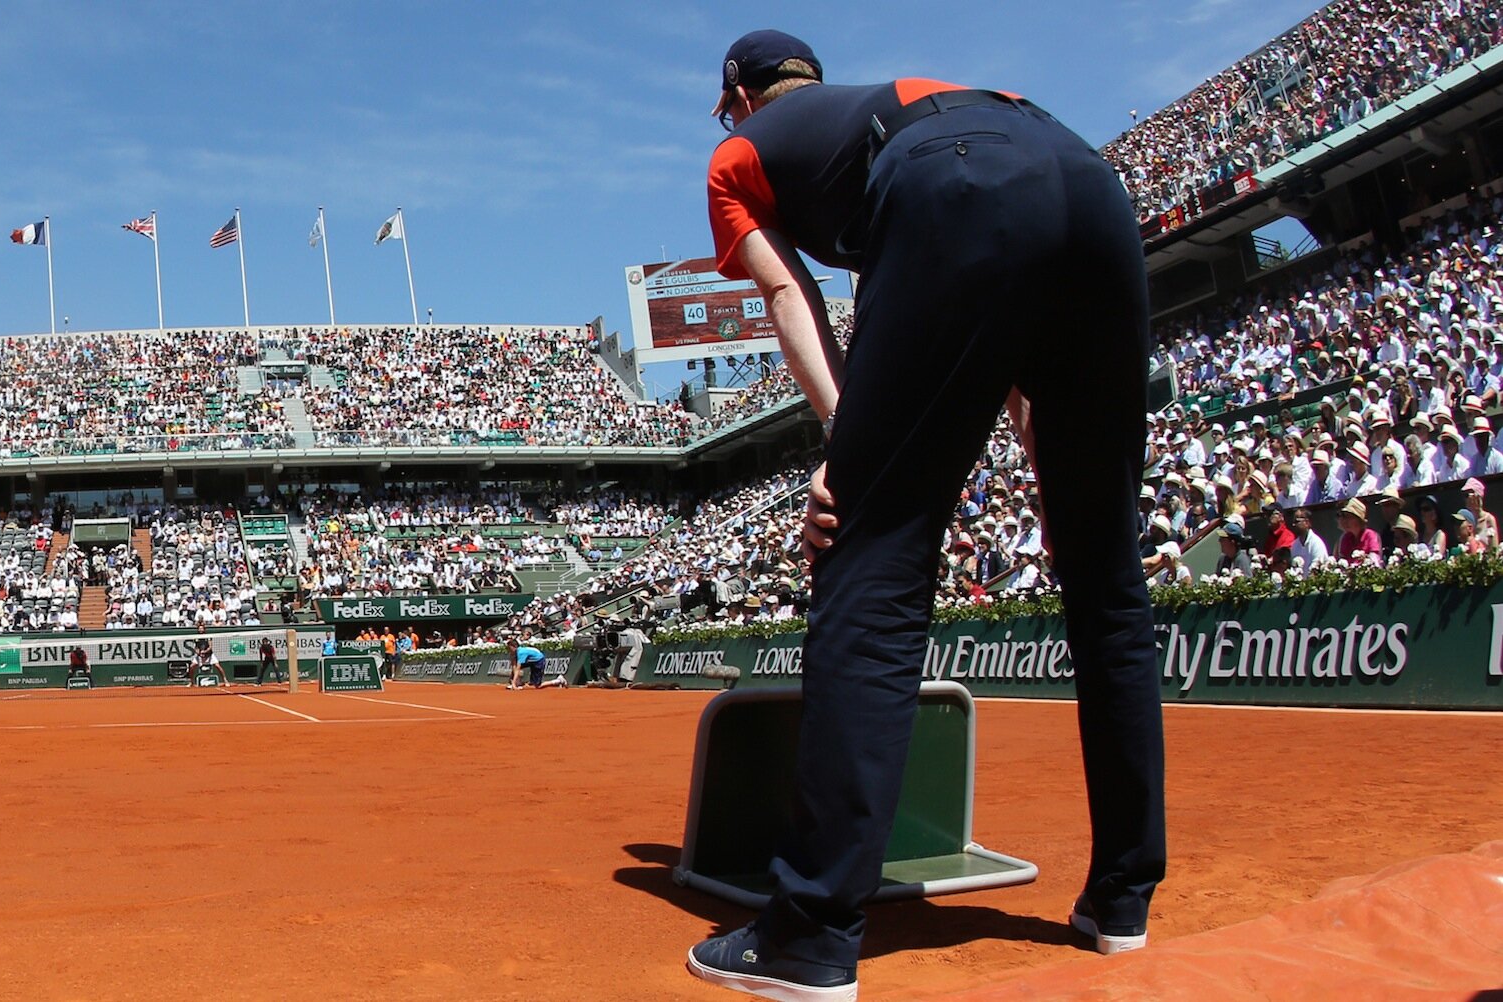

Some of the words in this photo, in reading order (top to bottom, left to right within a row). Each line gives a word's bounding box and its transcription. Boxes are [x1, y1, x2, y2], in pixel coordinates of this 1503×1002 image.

[688, 307, 704, 319] 40
[746, 301, 763, 314] 30
[707, 343, 745, 352] LONGINES
[333, 601, 385, 618] FedEx
[400, 600, 450, 616] FedEx
[465, 598, 514, 615] FedEx
[27, 646, 74, 662] BNP
[98, 639, 196, 660] PARIBAS
[342, 641, 381, 649] LONGINES
[1208, 613, 1409, 678] Emirates
[654, 650, 725, 675] LONGINES
[752, 646, 804, 675] LONG
[921, 636, 952, 681] ly
[330, 664, 371, 682] IBM
